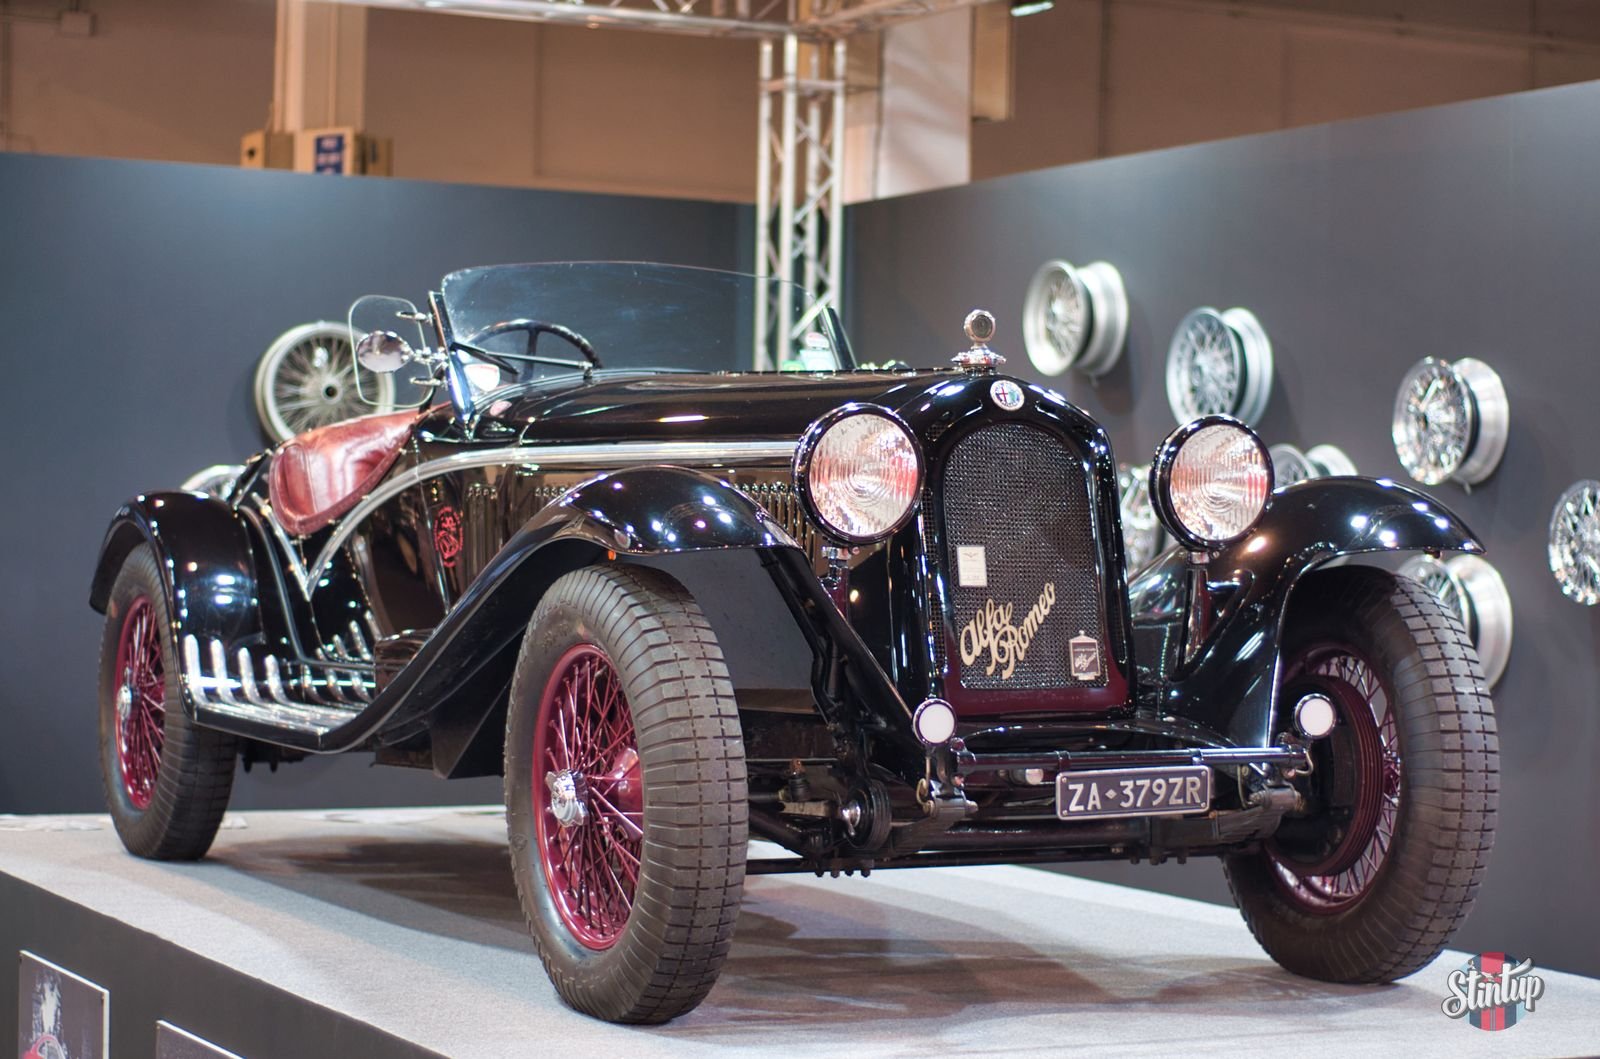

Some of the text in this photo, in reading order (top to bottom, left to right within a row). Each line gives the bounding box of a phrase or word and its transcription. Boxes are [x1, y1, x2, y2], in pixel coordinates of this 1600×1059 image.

[960, 598, 1013, 676] Alfa
[994, 581, 1056, 680] Romeo
[1068, 776, 1201, 812] ZA 379ZR
